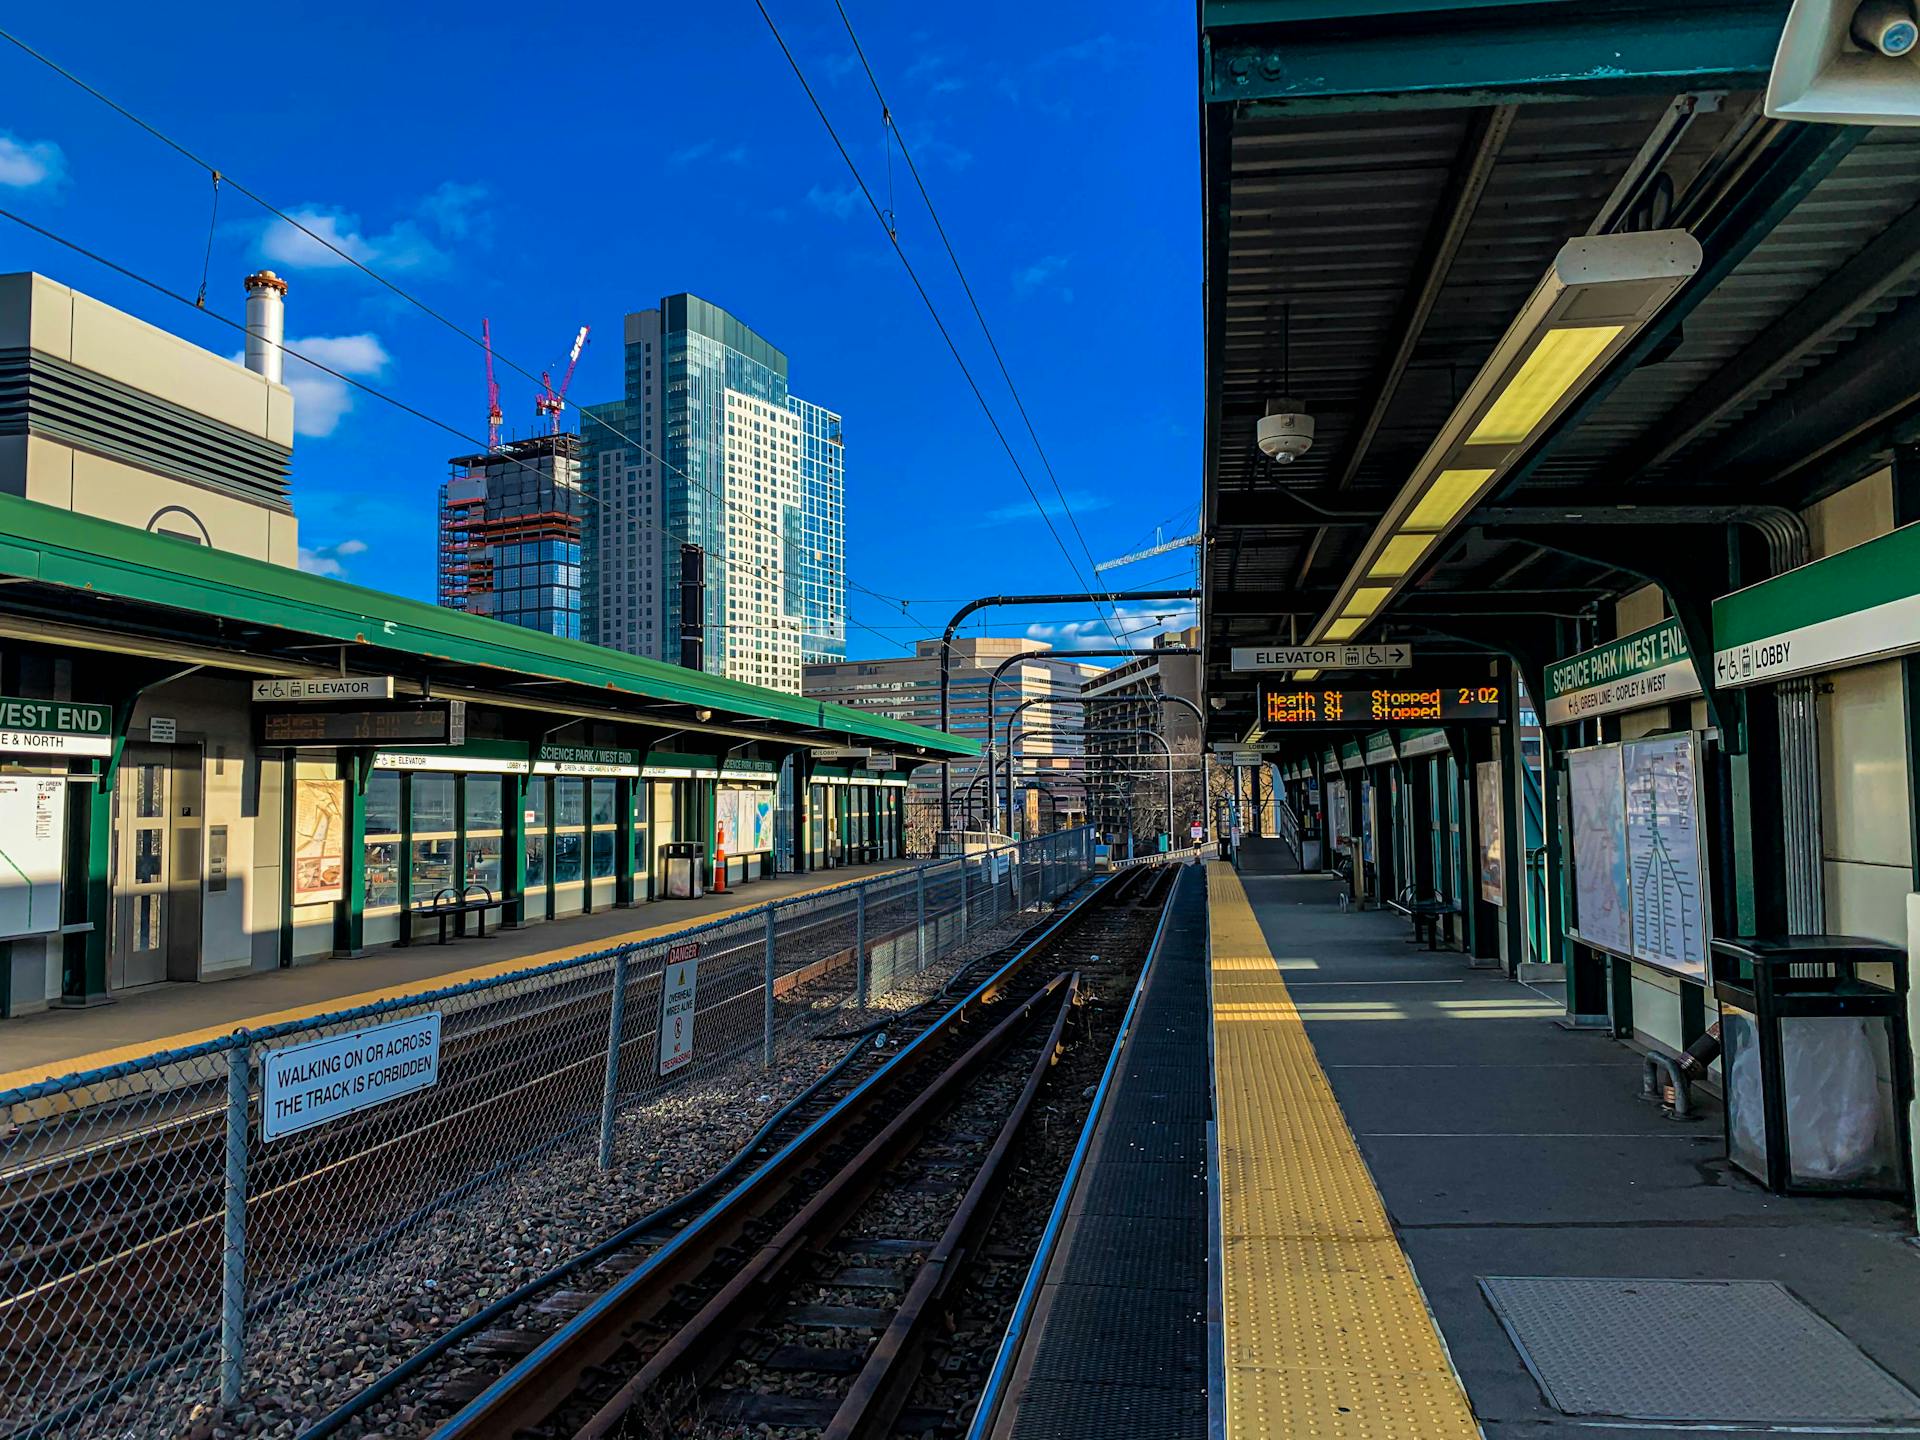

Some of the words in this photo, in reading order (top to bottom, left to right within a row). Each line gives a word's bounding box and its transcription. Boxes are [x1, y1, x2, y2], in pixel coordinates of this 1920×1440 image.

[1256, 651, 1335, 664] ELEVATOR
[1553, 659, 1589, 693] SCIENCE
[1591, 650, 1618, 682] PARK
[1619, 646, 1623, 675] /
[1624, 634, 1657, 671] WEST
[1755, 641, 1791, 668] LOBBY
[307, 682, 369, 694] ELEVATOR
[1267, 692, 1315, 707] Heath
[1323, 690, 1343, 705] St
[1372, 689, 1440, 705] Stopped
[1458, 687, 1499, 704] 2:02
[1580, 692, 1599, 710] GREEN
[1599, 690, 1611, 705] LINE
[1616, 680, 1640, 701] COPLEY
[1641, 679, 1646, 694] &
[1647, 673, 1666, 693] WEST
[58, 707, 102, 731] END
[1267, 706, 1316, 721] Heath
[1324, 705, 1343, 720] St
[1372, 704, 1441, 720] Stopped
[12, 734, 19, 745] &
[24, 735, 64, 747] NORTH
[398, 756, 426, 766] ELEVATOR
[541, 746, 573, 761] SCIENCE
[575, 748, 594, 761] PARK
[599, 750, 618, 763] WEST
[619, 751, 631, 763] END
[669, 943, 698, 963] DANGER
[668, 987, 692, 1004] OVERHEAD
[666, 1006, 680, 1017] WIRES
[681, 1000, 693, 1013] ALIVE
[277, 1055, 341, 1088] WALKING
[344, 1050, 363, 1069] ON
[366, 1044, 383, 1062] OR
[385, 1030, 432, 1058] ACROSS
[275, 1094, 303, 1118] THE
[306, 1080, 351, 1109] TRACK
[353, 1076, 364, 1094] IS
[368, 1054, 432, 1089] FORBIDDEN
